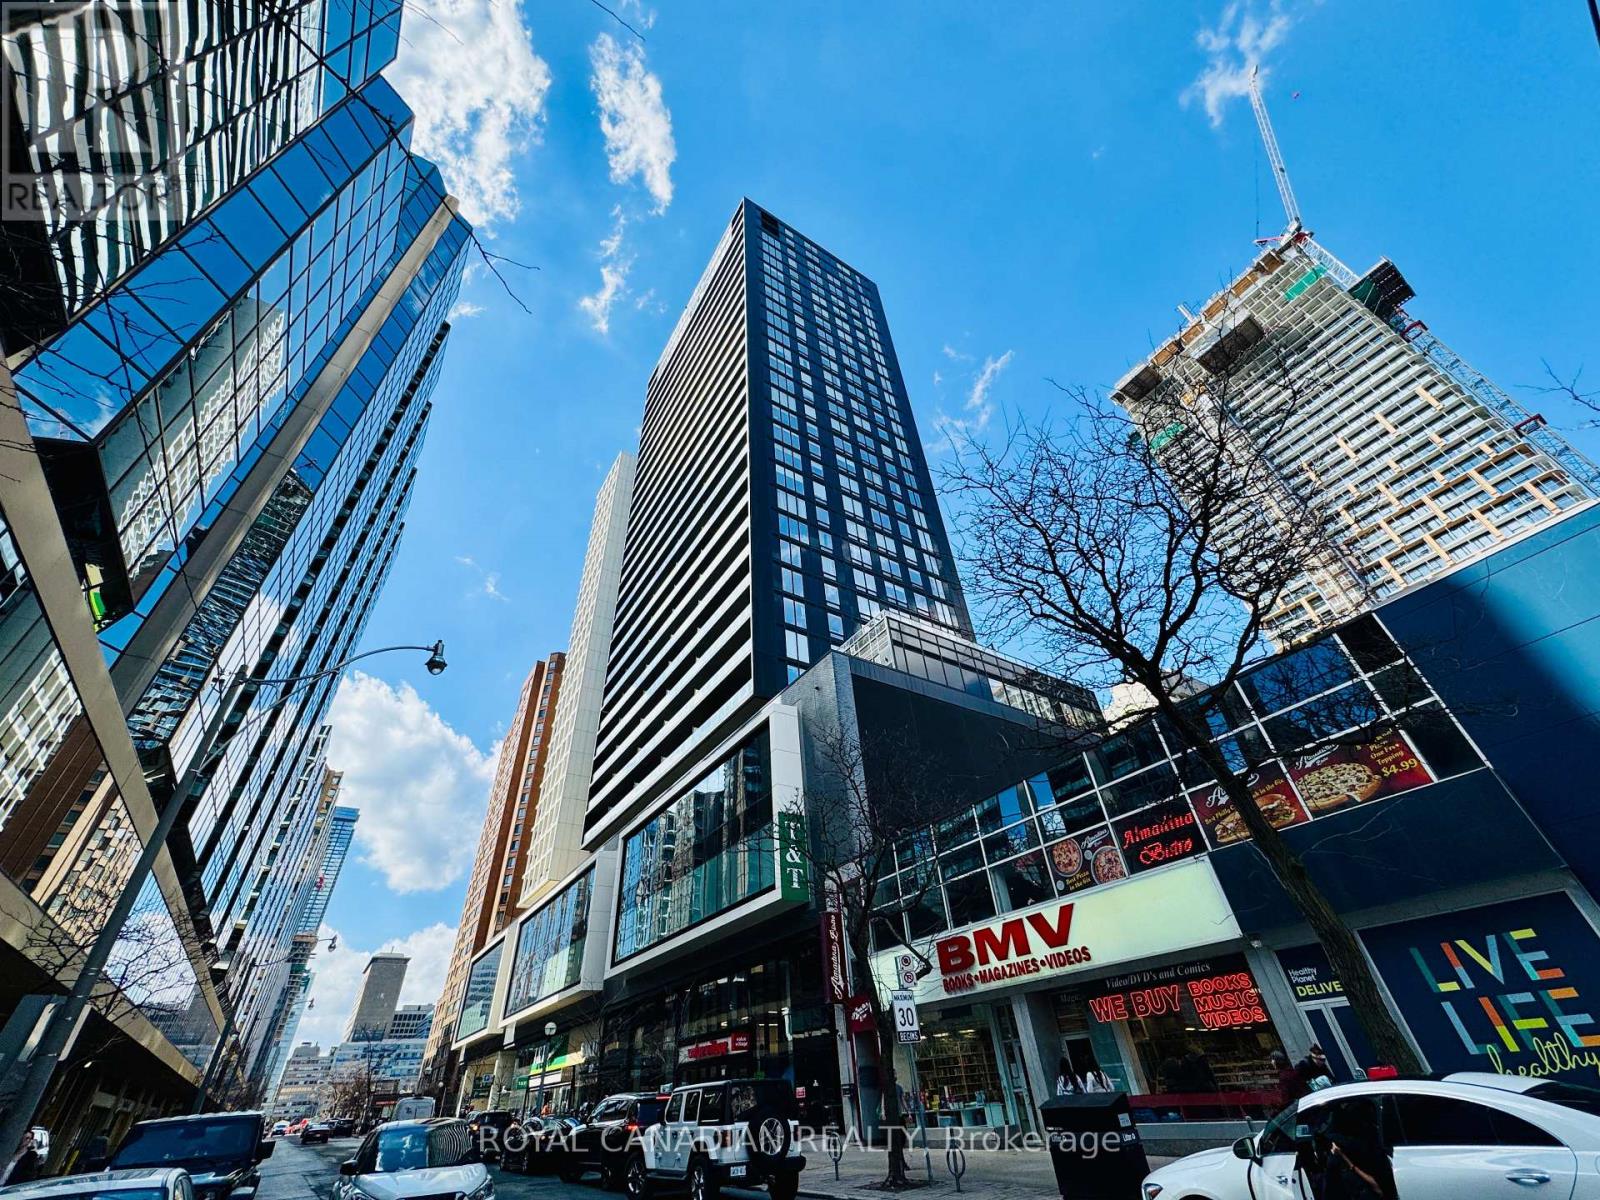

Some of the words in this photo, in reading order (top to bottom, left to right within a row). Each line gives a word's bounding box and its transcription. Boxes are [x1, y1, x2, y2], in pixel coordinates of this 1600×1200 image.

[1377, 751, 1404, 766] Topping
[1382, 758, 1417, 777] $4.99
[936, 902, 1075, 977] BMV
[942, 973, 977, 994] BOOKS
[978, 957, 1041, 984] MAGAZINES
[1044, 946, 1092, 969] VIDEOS
[1288, 967, 1317, 977] Healthy
[1409, 928, 1565, 993] LIVE
[1106, 971, 1159, 989] Video/DVD's
[1158, 968, 1176, 981] and
[1176, 962, 1211, 977] Comics
[1187, 973, 1252, 996] BOOKS
[1291, 974, 1316, 983] Planet
[1296, 981, 1344, 997] DELIVE
[1089, 994, 1129, 1023] WE
[1130, 985, 1180, 1018] BUY
[1193, 989, 1259, 1013] MUSIC
[898, 1007, 914, 1027] 30
[1200, 1006, 1267, 1028] VIDEOS
[1441, 987, 1600, 1055] LIFE
[900, 1030, 919, 1041] BEGINS
[1487, 1032, 1600, 1077] healthy
